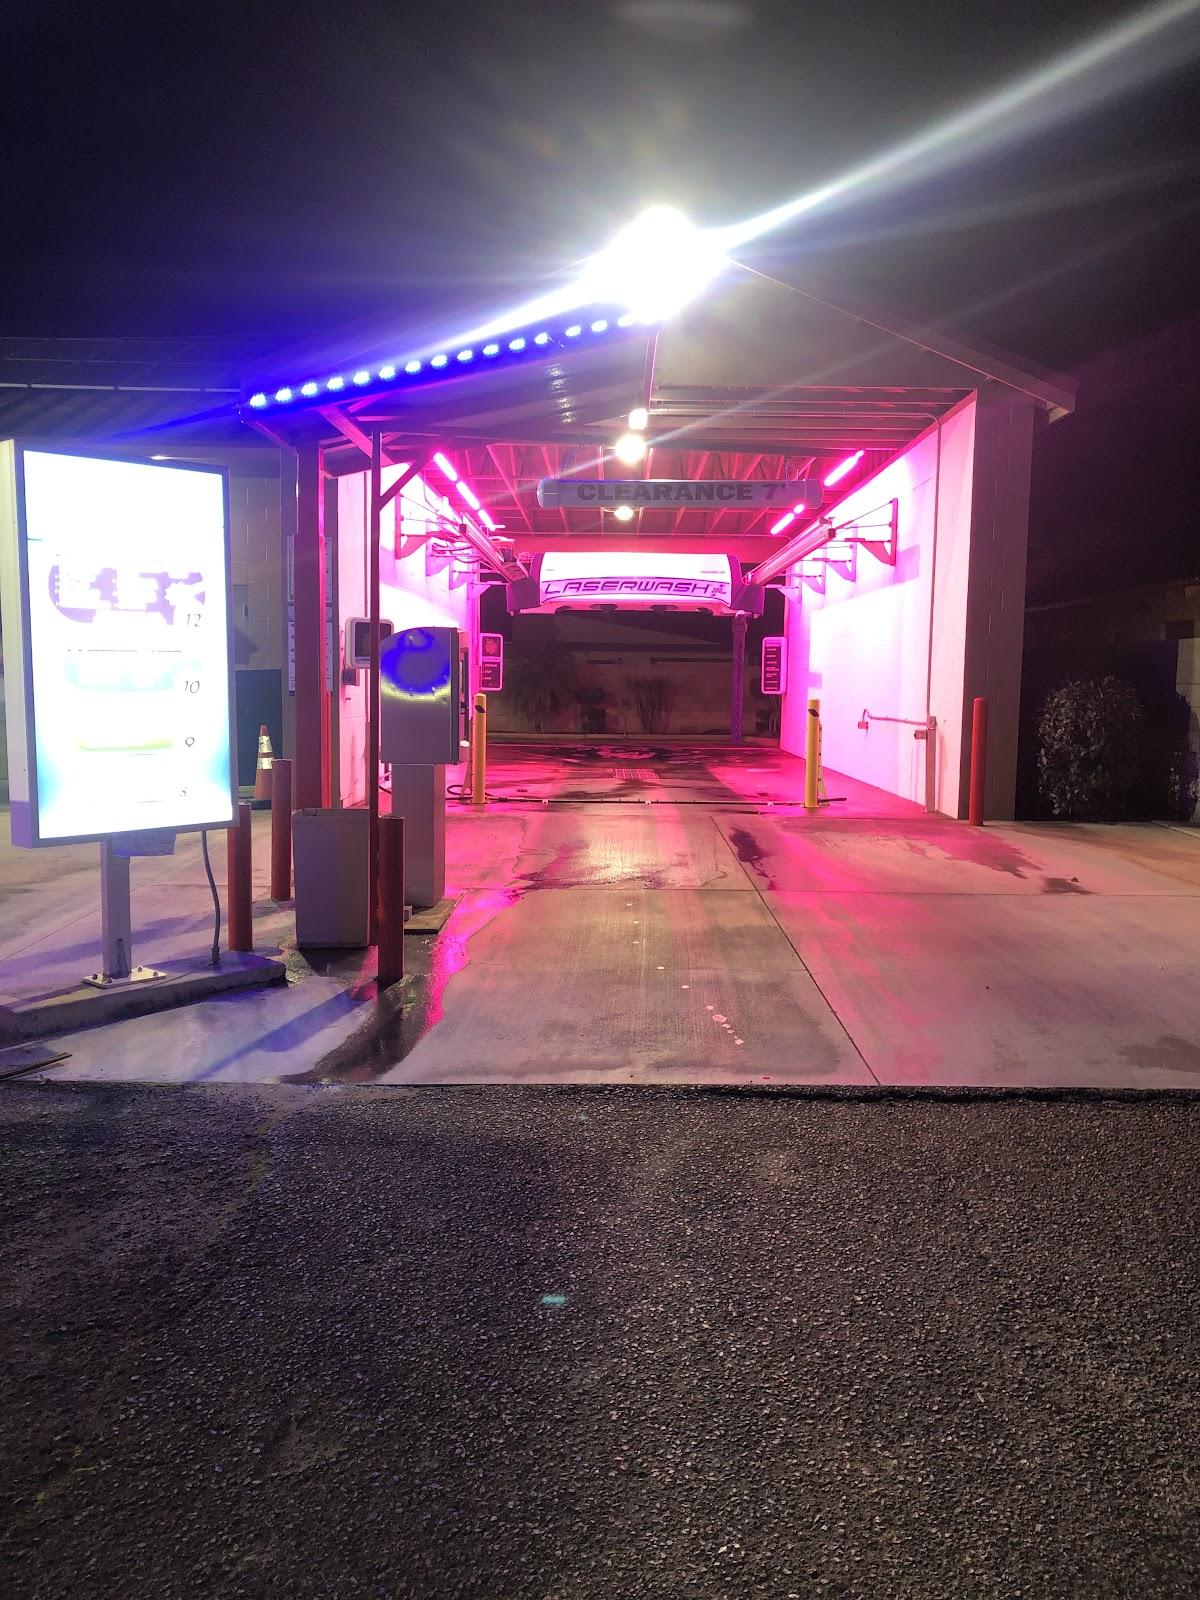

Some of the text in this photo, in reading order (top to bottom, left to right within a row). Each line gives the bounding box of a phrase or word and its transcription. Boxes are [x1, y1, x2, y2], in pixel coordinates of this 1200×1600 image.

[577, 484, 752, 500] CLEARANCE
[544, 580, 710, 595] LASERWASH
[184, 680, 200, 694] 10
